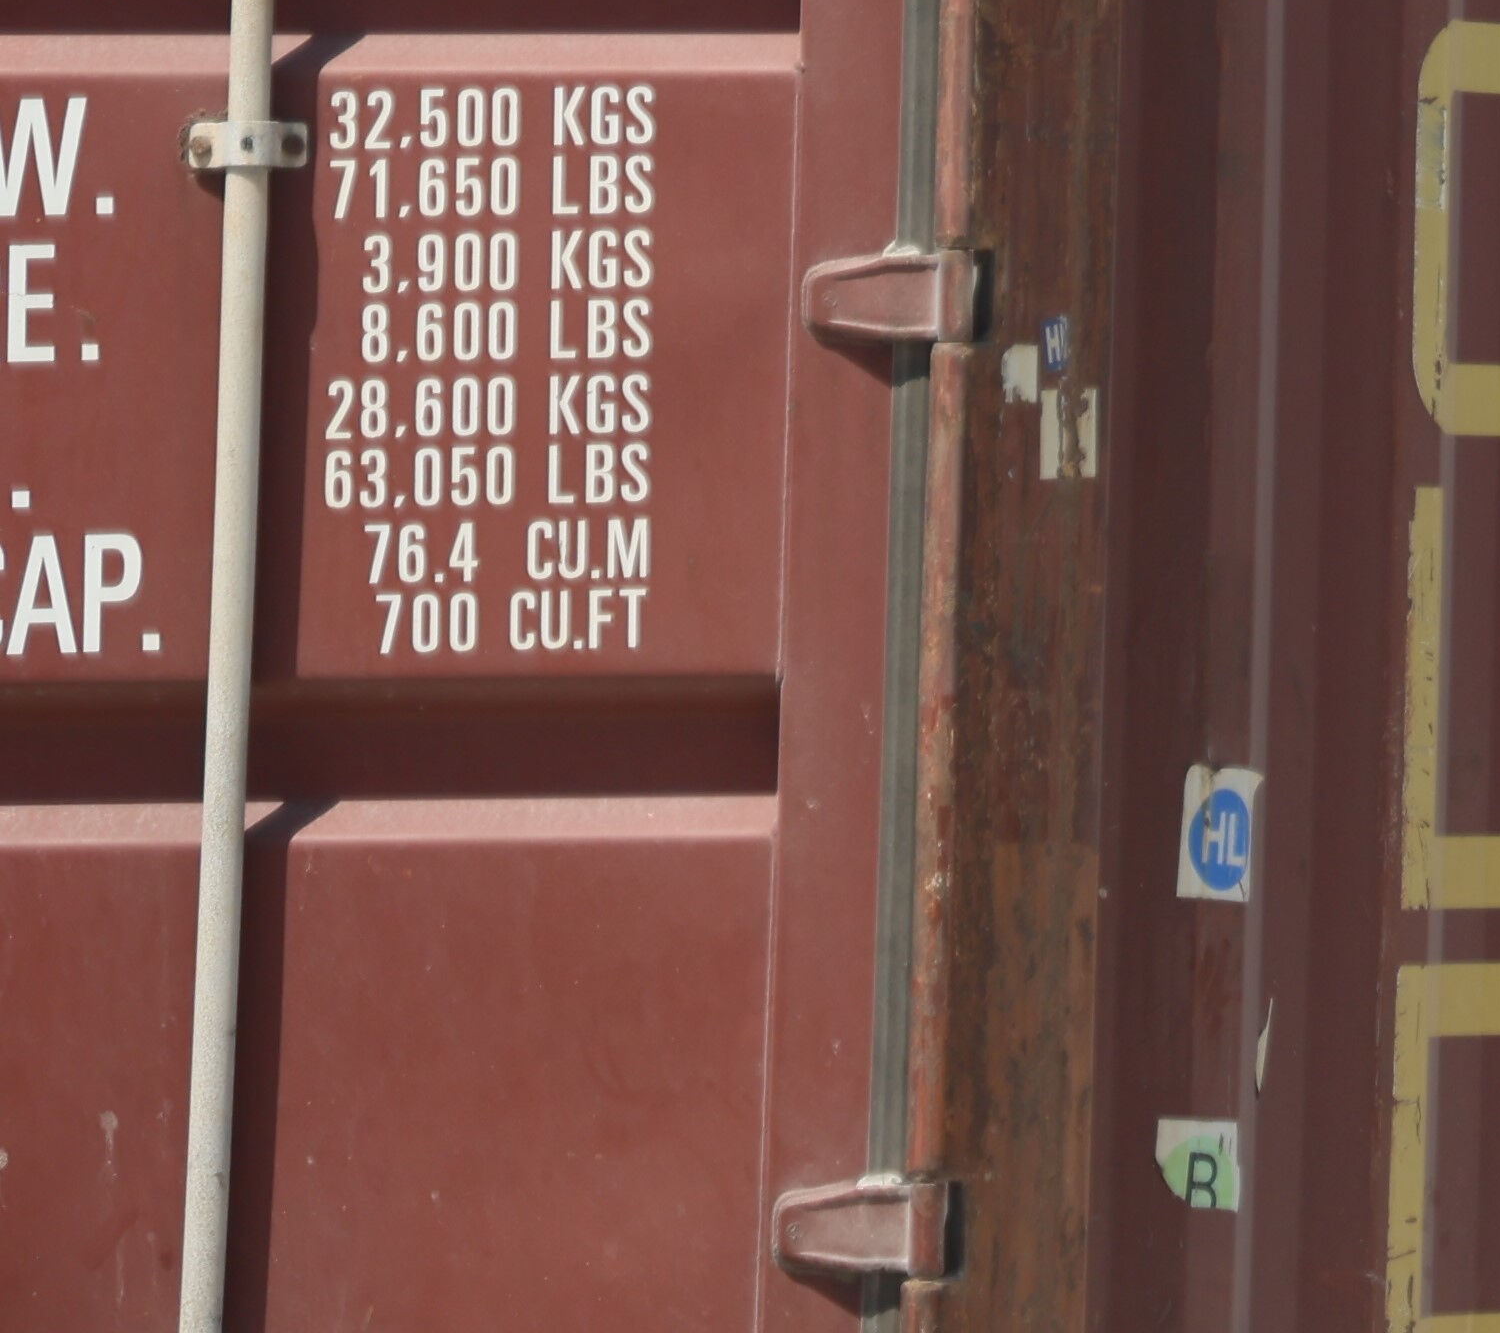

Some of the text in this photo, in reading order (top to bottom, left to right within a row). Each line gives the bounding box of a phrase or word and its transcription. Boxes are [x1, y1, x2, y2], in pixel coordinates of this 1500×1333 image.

[329, 85, 653, 150] 32,500 KGS
[329, 154, 653, 220] 71,650 LBS
[362, 229, 652, 294] 3,900 KGS
[361, 298, 651, 363] 8,600 LBS
[324, 373, 650, 440] 28,600 KGS
[324, 443, 649, 509] 63,050 LBS
[363, 518, 649, 584] 76.4 CU.M
[375, 588, 648, 654] 700 CU.FT
